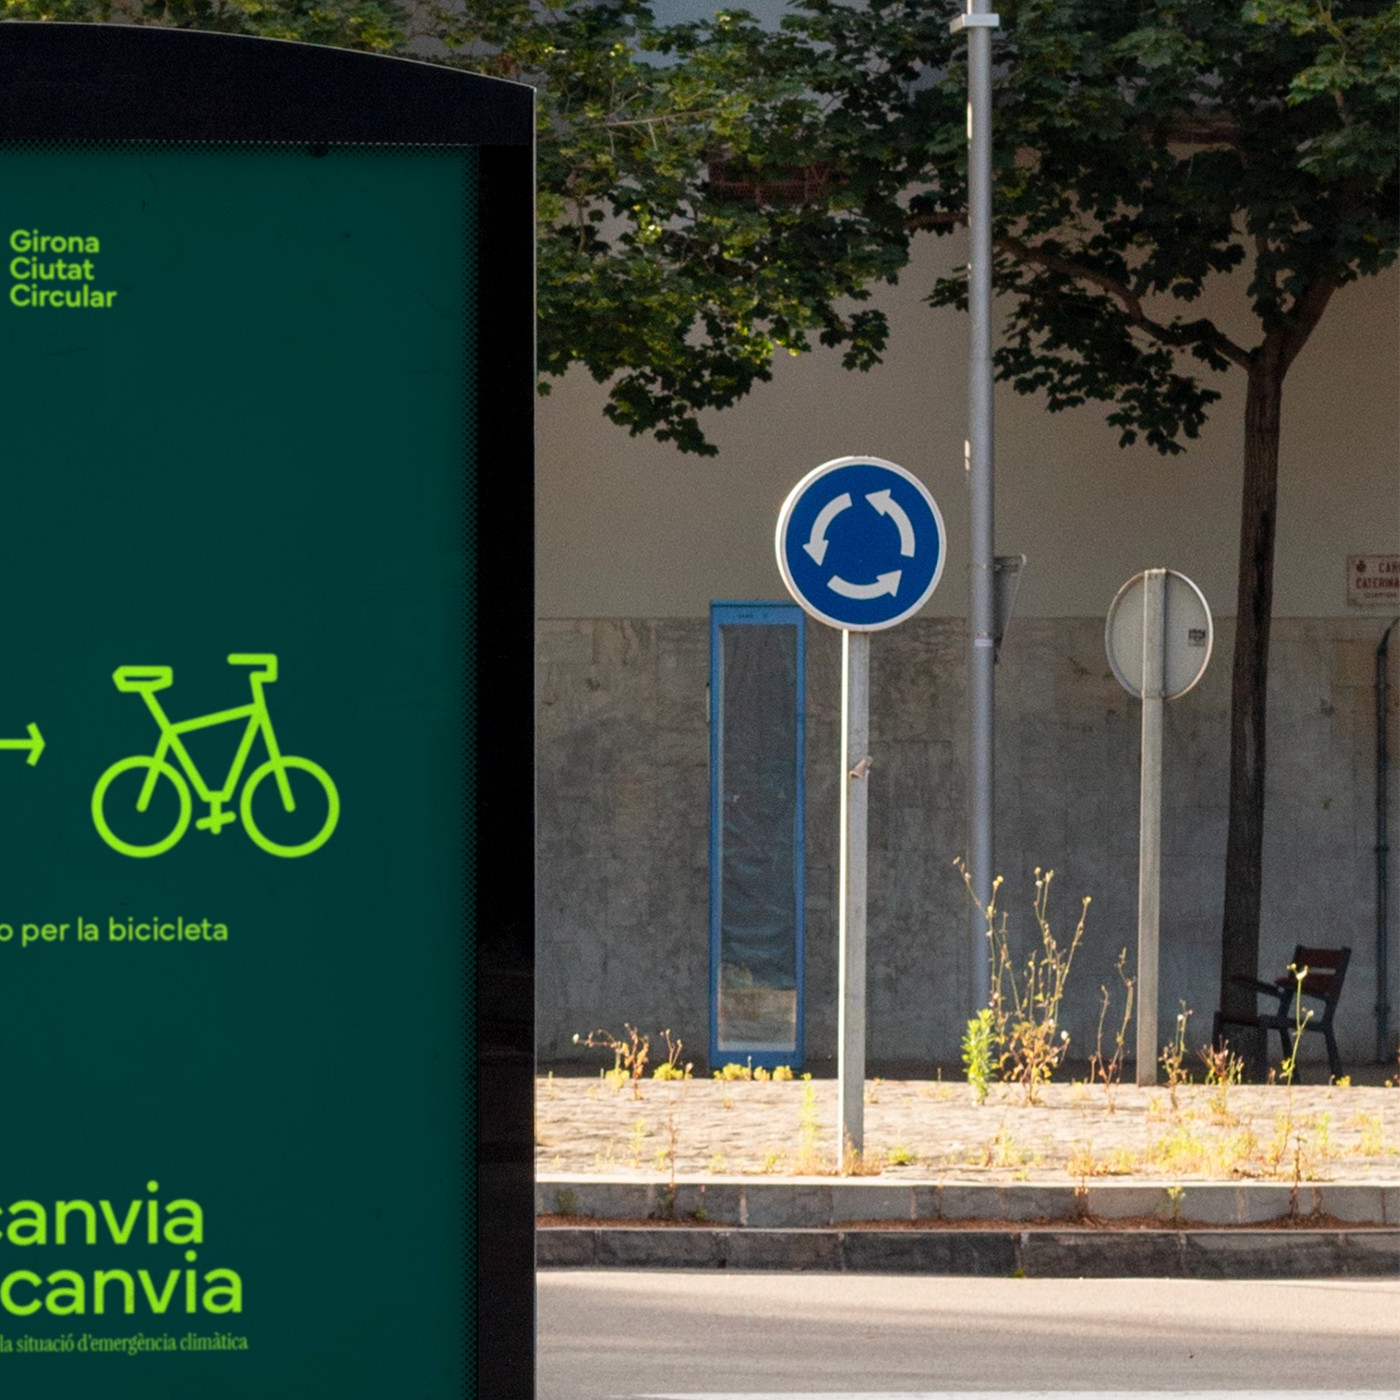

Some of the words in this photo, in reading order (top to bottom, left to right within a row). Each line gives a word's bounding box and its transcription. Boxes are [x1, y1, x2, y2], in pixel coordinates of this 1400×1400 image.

[9, 229, 100, 253] Girona
[9, 257, 95, 280] Ciutat
[9, 284, 118, 307] Circular
[22, 924, 71, 948] per
[78, 917, 99, 942] la
[108, 917, 228, 942] bicicleta
[0, 1250, 243, 1316] canvia
[0, 1335, 13, 1353] la
[16, 1334, 75, 1352] situació
[180, 1332, 248, 1351] climàtica
